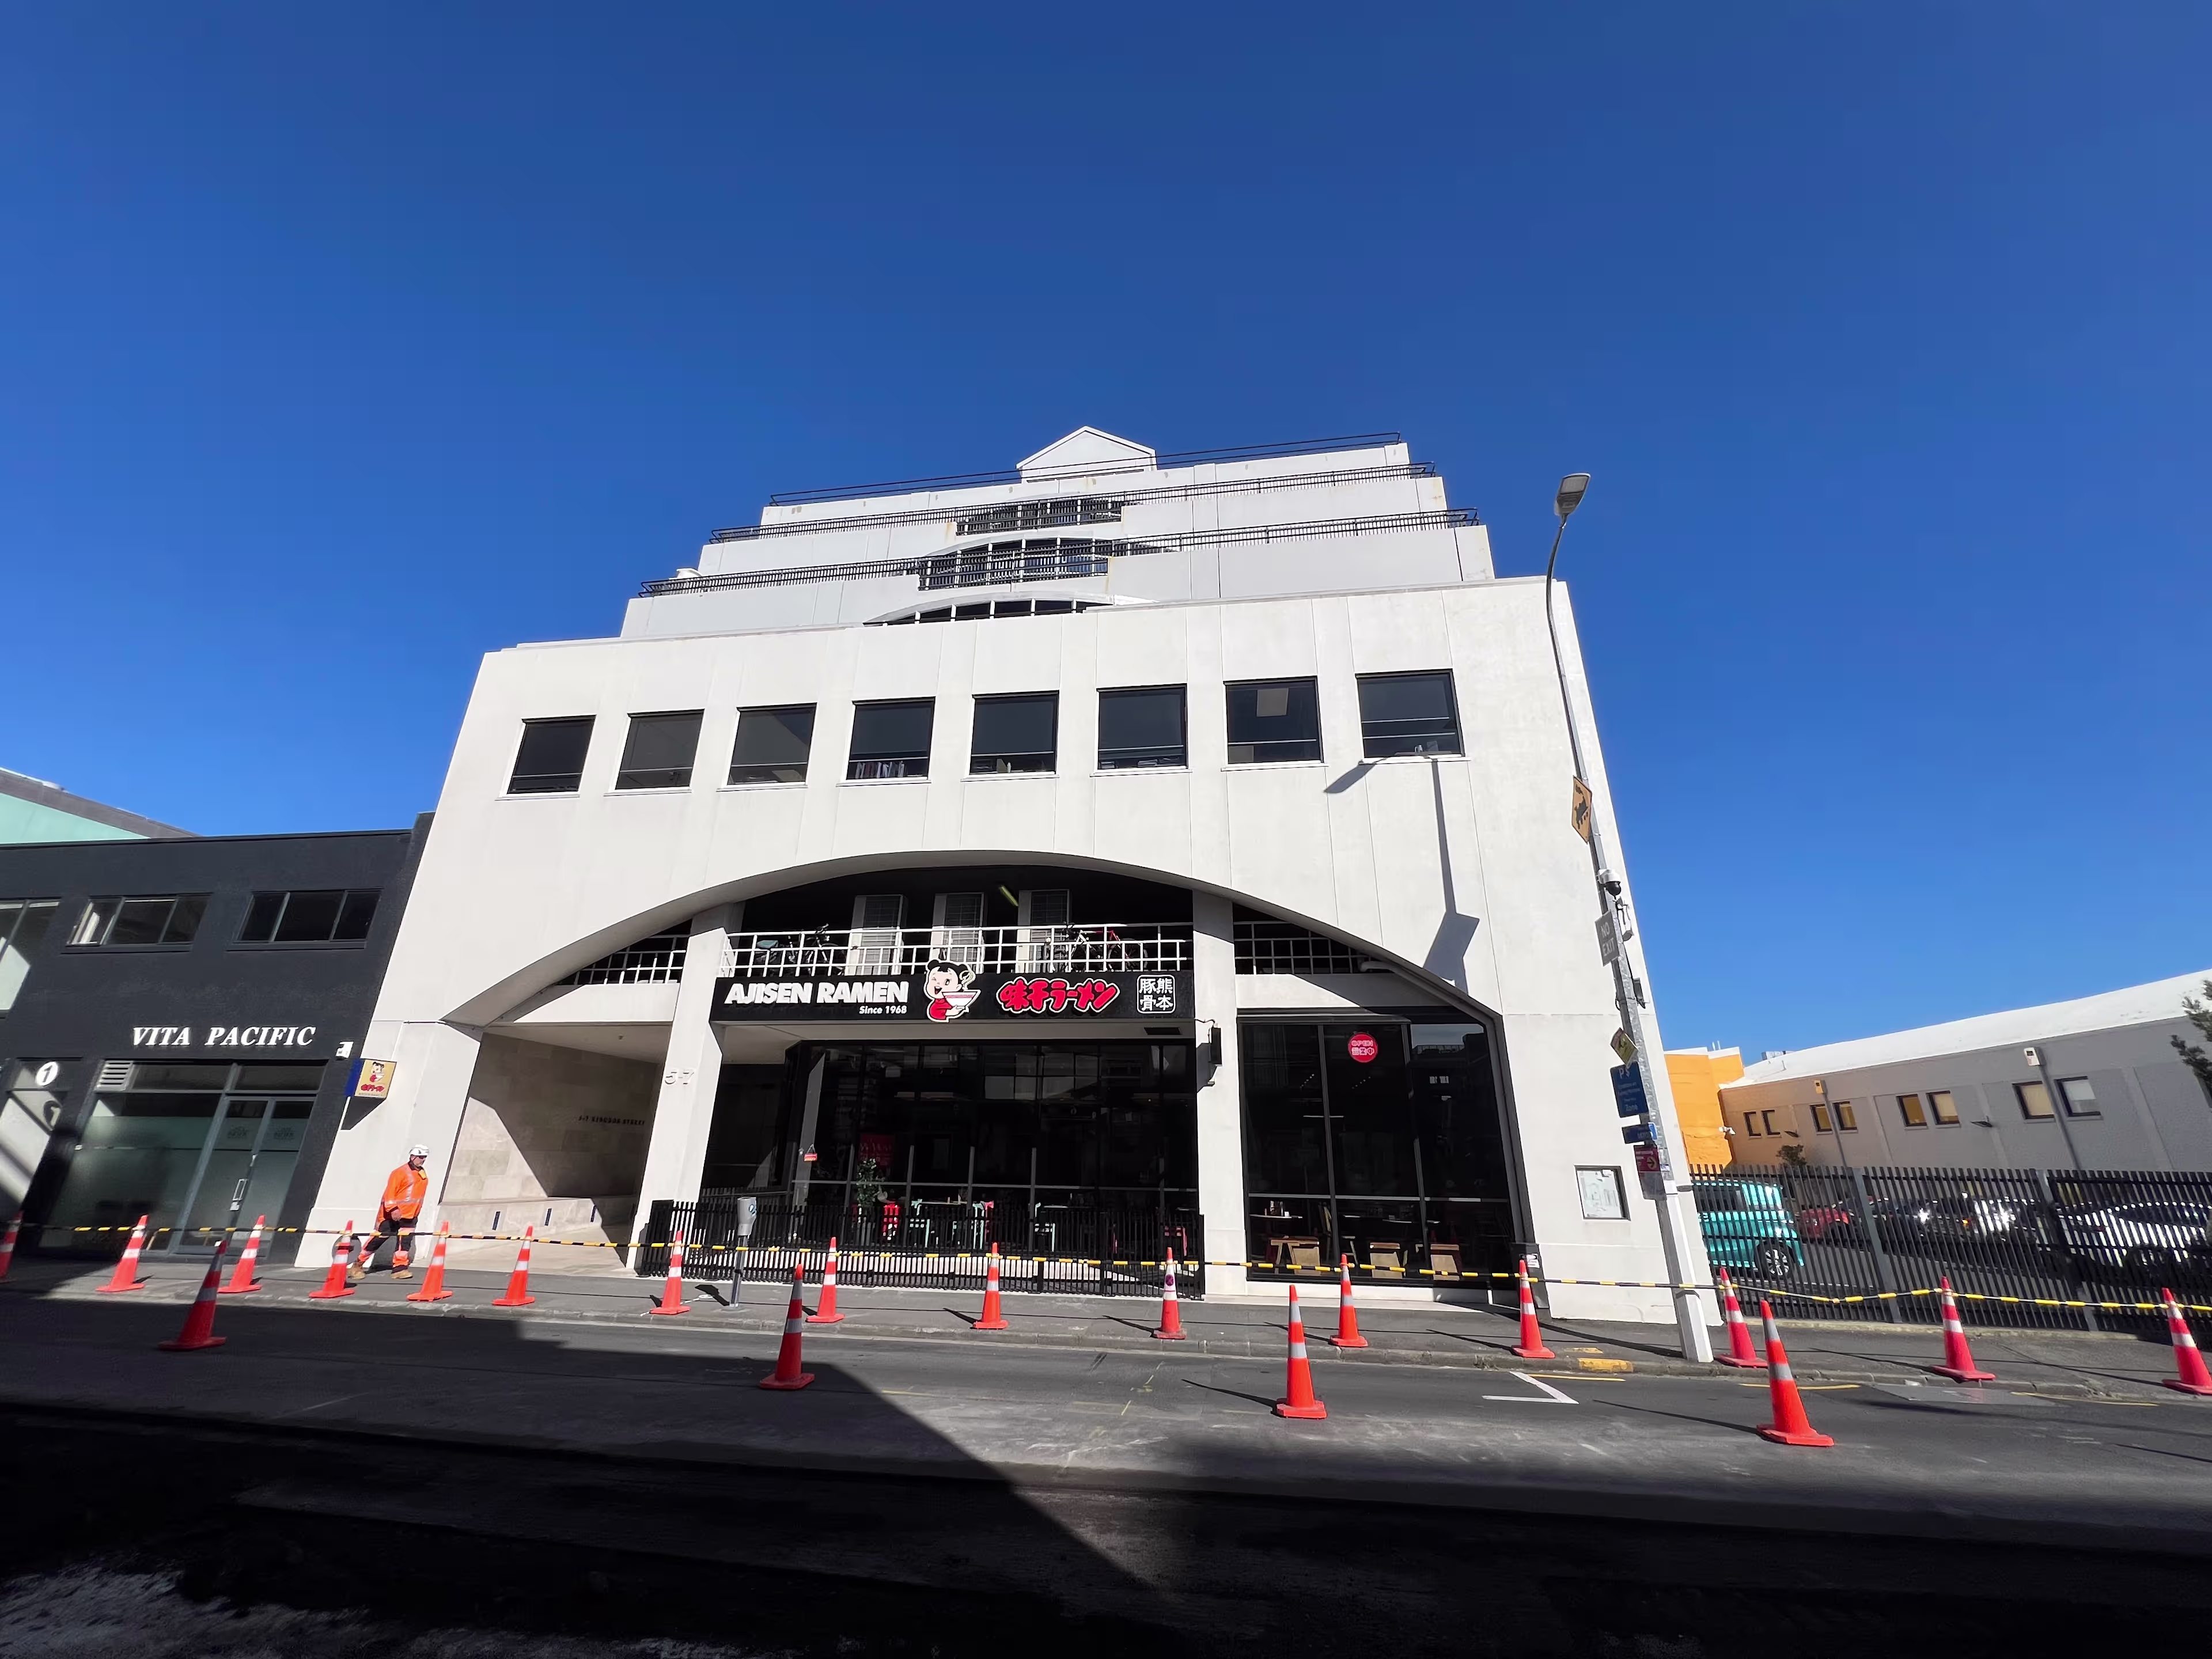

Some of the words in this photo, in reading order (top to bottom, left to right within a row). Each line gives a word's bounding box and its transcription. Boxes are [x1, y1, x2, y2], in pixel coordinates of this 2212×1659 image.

[1600, 922, 1610, 937] NO
[1602, 938, 1615, 956] EXIT
[724, 982, 813, 1004] AJISEN
[816, 981, 909, 1003] RAMEN
[997, 976, 1120, 1013] 味千ラーメン
[859, 1005, 882, 1014] Since
[885, 1005, 907, 1014] 1968
[133, 1027, 191, 1046] VITA
[204, 1026, 316, 1046] PACIFIC
[41, 1065, 54, 1083] 1
[664, 1069, 695, 1085] 5-7
